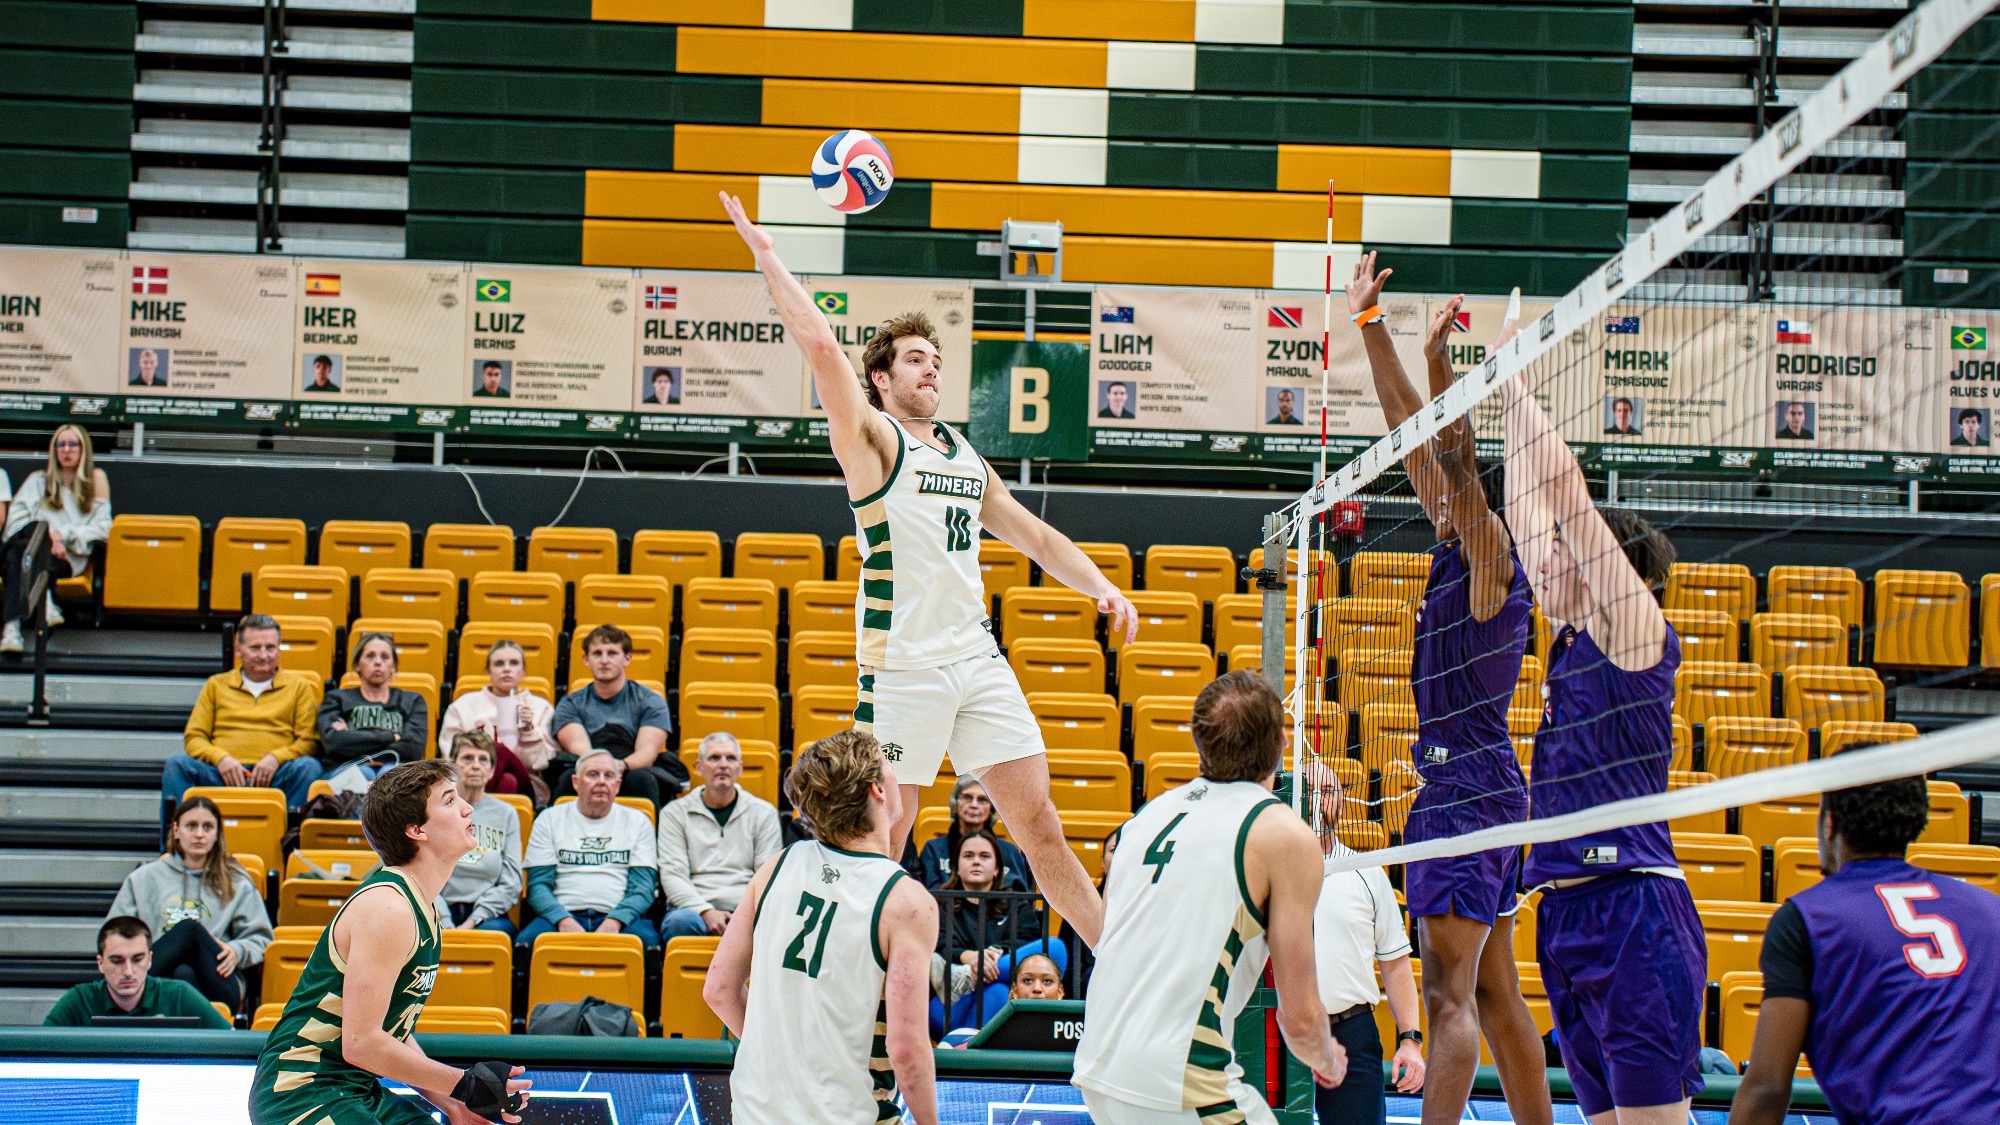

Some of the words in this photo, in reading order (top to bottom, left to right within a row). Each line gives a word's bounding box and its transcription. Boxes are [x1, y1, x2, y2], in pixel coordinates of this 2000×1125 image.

[131, 300, 186, 321] MIKE
[304, 306, 356, 328] IKER
[475, 312, 525, 333] LUIZ
[644, 319, 784, 343] ALEXANDER
[303, 332, 358, 345] BERMEJO
[1099, 333, 1153, 355] LIAM
[643, 345, 682, 357] BURUM
[1267, 340, 1324, 361] ZYON
[1604, 349, 1669, 371] MARK
[1099, 359, 1152, 372] GOODGER
[1776, 353, 1876, 376] RODRIGO
[1604, 375, 1669, 388] TOMASOVIC
[1776, 380, 1823, 392] VARGAS
[1950, 386, 1988, 397] ALVES
[1009, 367, 1050, 434] B
[922, 473, 981, 497] MINERS
[945, 505, 972, 552] 10
[584, 851, 628, 865] VOLLEYBALL
[1142, 812, 1189, 884] 4
[782, 890, 839, 979] 21
[1874, 882, 1969, 979] 5
